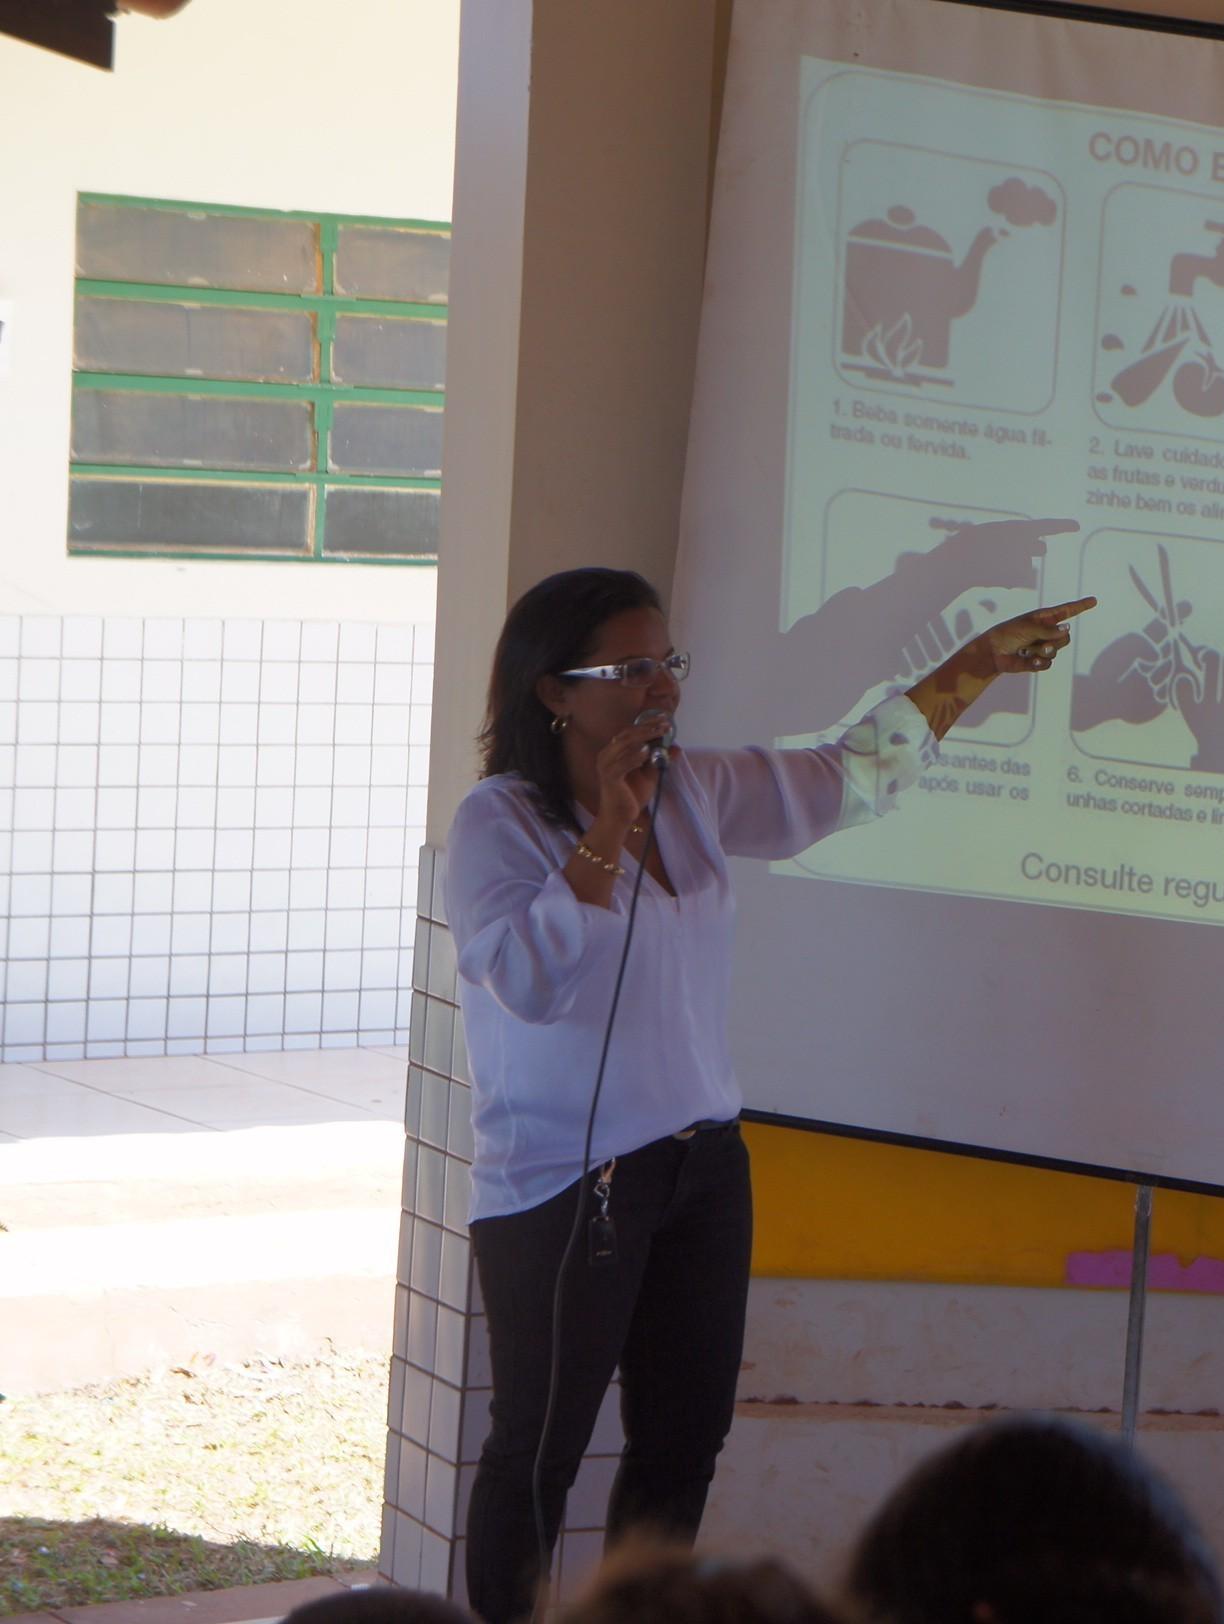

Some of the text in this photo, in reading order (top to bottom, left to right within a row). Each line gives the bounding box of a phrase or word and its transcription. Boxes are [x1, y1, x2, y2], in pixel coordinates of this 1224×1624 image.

[1088, 131, 1199, 176] COMO
[833, 398, 848, 416] 1.
[852, 401, 898, 424] Beba
[904, 411, 978, 437] somente
[830, 423, 972, 460] trada ou fervida.
[1088, 436, 1104, 455] 2.
[1114, 439, 1154, 460] Lave
[1087, 465, 1108, 481] as
[1112, 464, 1161, 487] frutas
[1164, 475, 1175, 488] e
[1086, 488, 1132, 509] zinhe
[1135, 492, 1172, 513] bem
[1176, 501, 1196, 516] os
[951, 752, 997, 772] antes
[1000, 757, 1031, 776] das
[918, 773, 1030, 801] após usar os
[1066, 765, 1083, 784] 6.
[1094, 768, 1175, 795] Conserve
[1066, 790, 1117, 812] unhas
[1120, 798, 1193, 822] cortadas
[1196, 808, 1207, 823] e
[1019, 851, 1154, 895] Consulte
